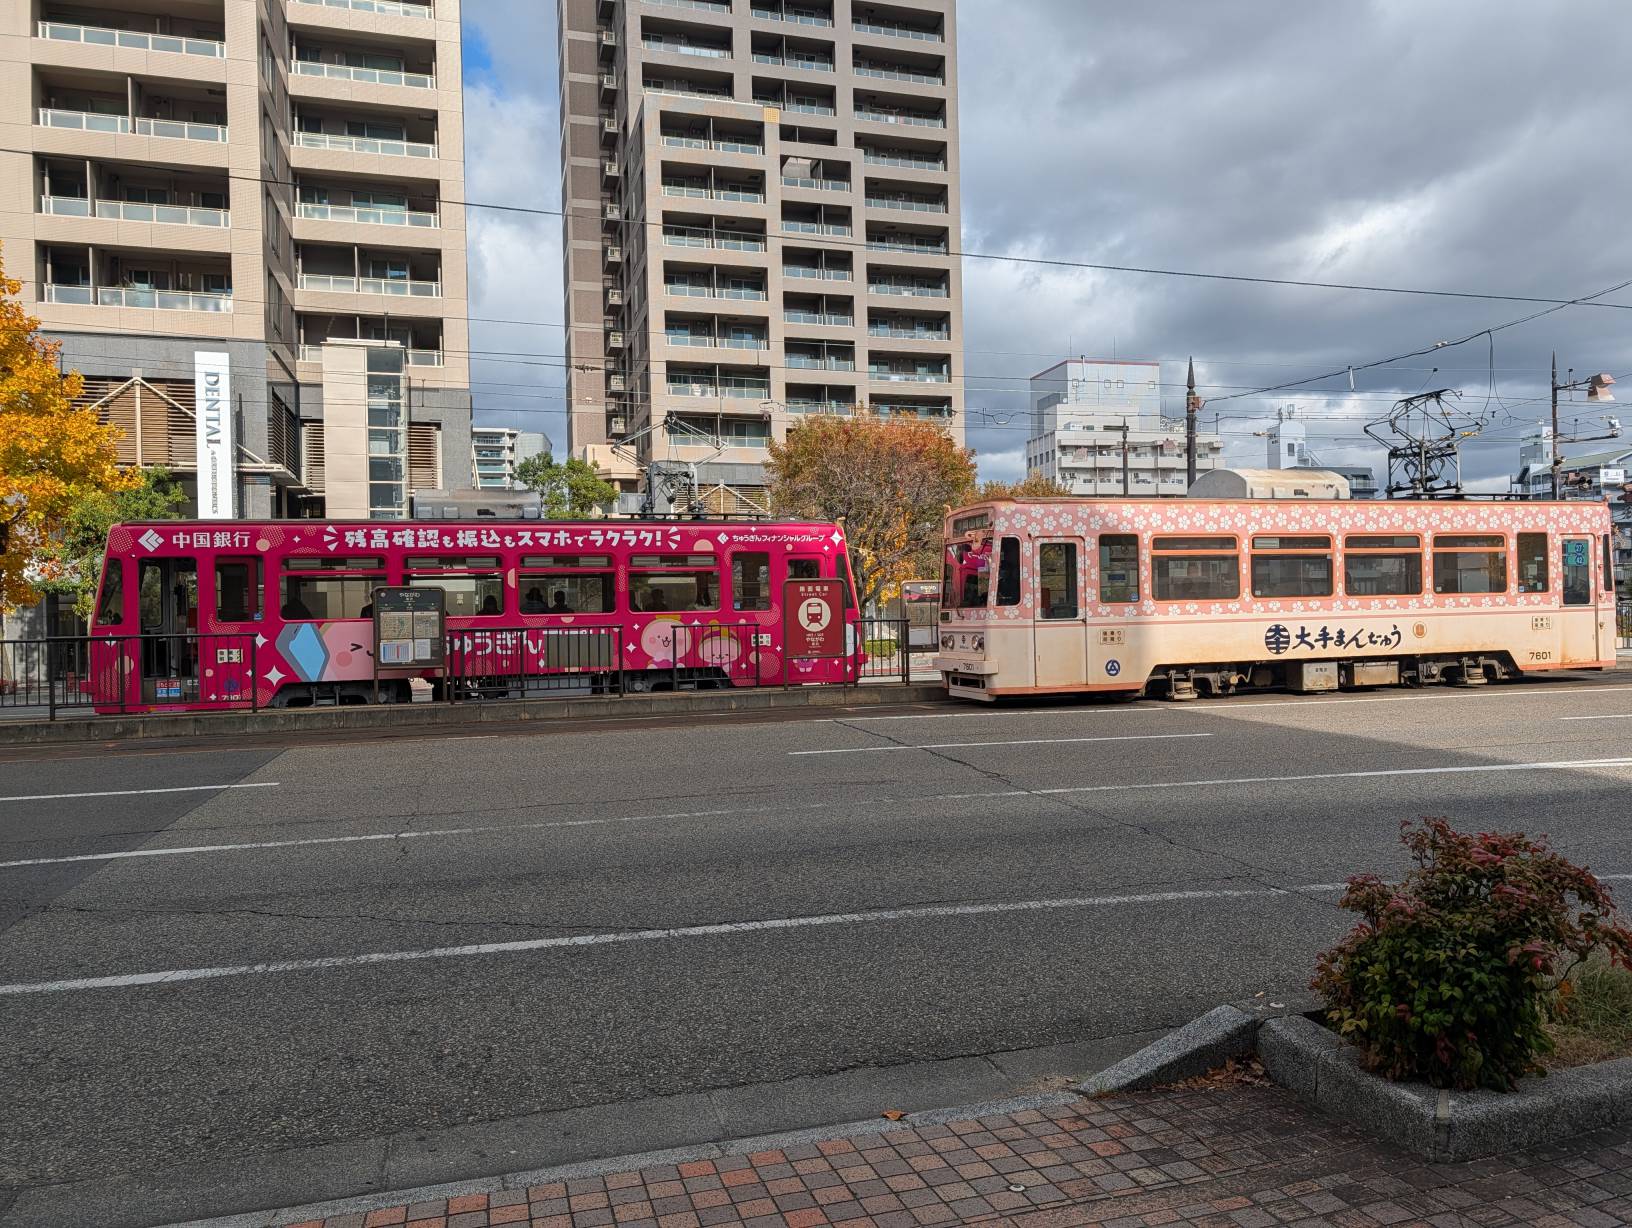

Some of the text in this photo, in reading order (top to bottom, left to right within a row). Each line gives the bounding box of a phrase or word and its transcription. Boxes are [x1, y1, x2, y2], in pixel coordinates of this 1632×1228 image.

[205, 371, 222, 449] DENTAL
[172, 531, 251, 549] 中国銀行
[344, 528, 662, 549] 残高確認も振込もスマホでラクラク!
[1528, 651, 1552, 661] 7601
[962, 662, 975, 672] 7601
